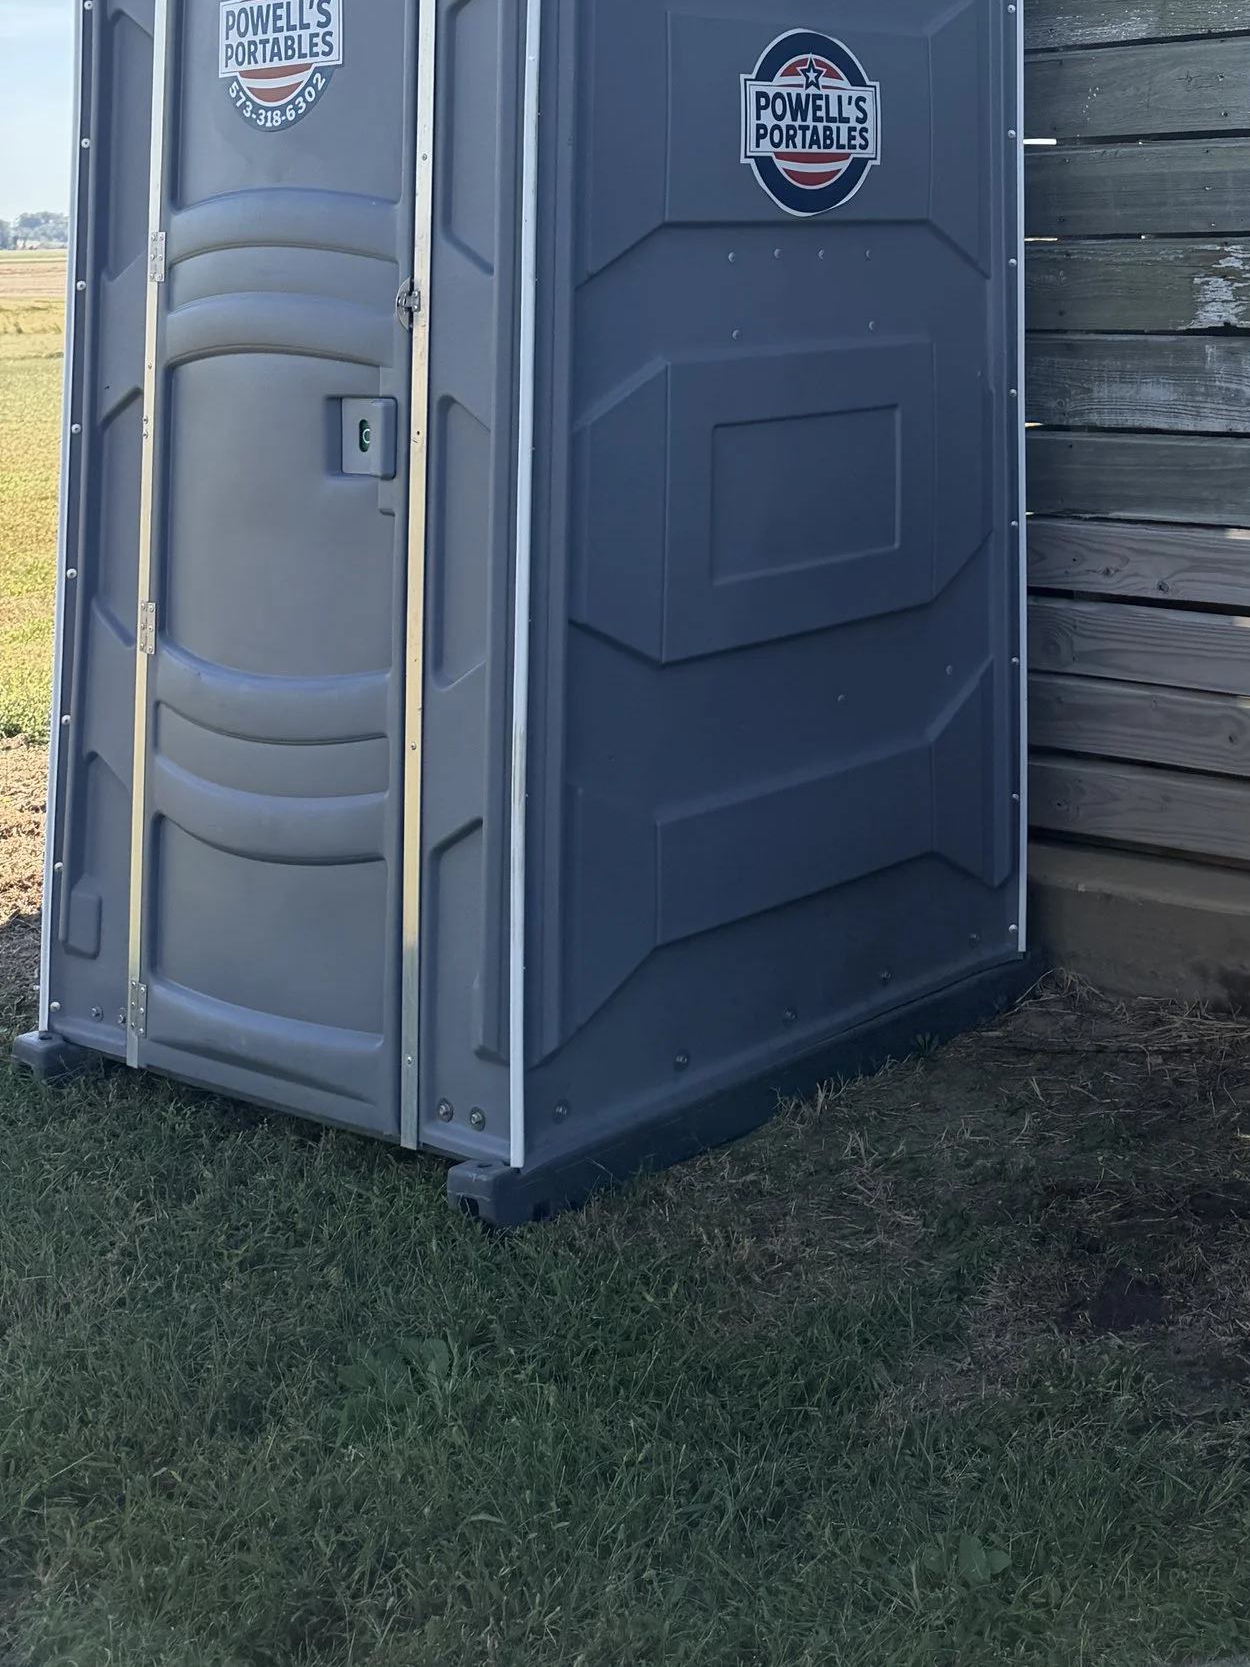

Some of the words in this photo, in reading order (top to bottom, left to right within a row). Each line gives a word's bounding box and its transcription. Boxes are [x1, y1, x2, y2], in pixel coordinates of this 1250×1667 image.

[224, 30, 334, 68] PORTABLES
[228, 72, 326, 127] 573-318-6302
[755, 90, 868, 124] POWELL'S
[755, 123, 869, 150] PORTABLES
